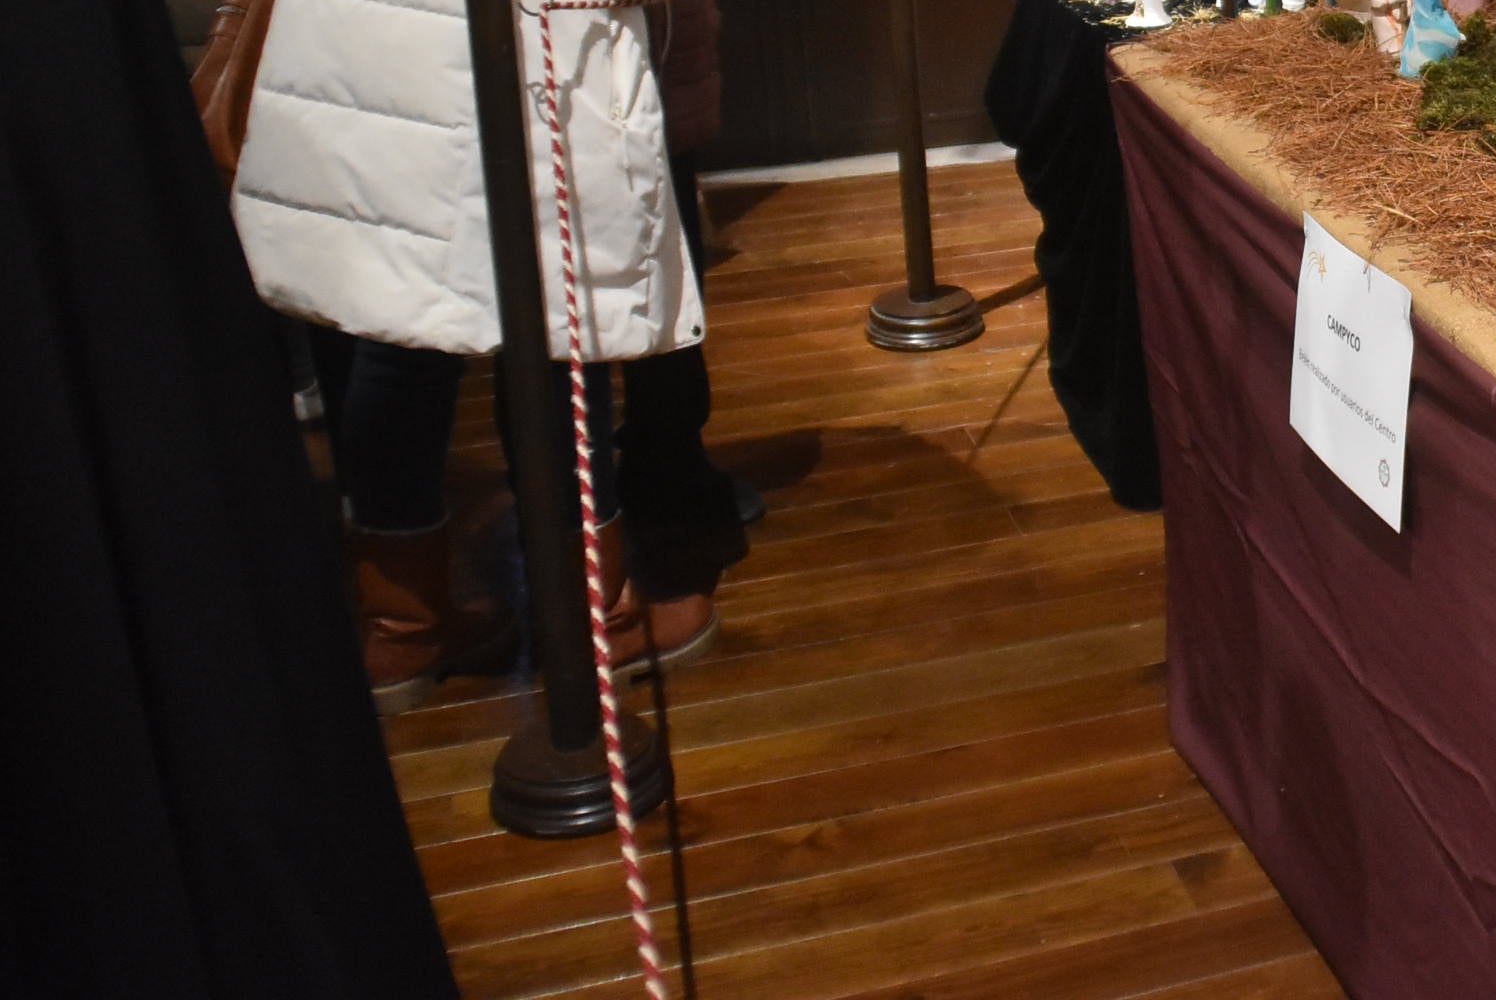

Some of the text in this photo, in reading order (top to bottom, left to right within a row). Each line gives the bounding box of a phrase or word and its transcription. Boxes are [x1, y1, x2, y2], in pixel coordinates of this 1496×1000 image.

[1327, 313, 1361, 353] CAMPYCO
[1364, 409, 1374, 426] del
[1374, 417, 1396, 444] Centro
